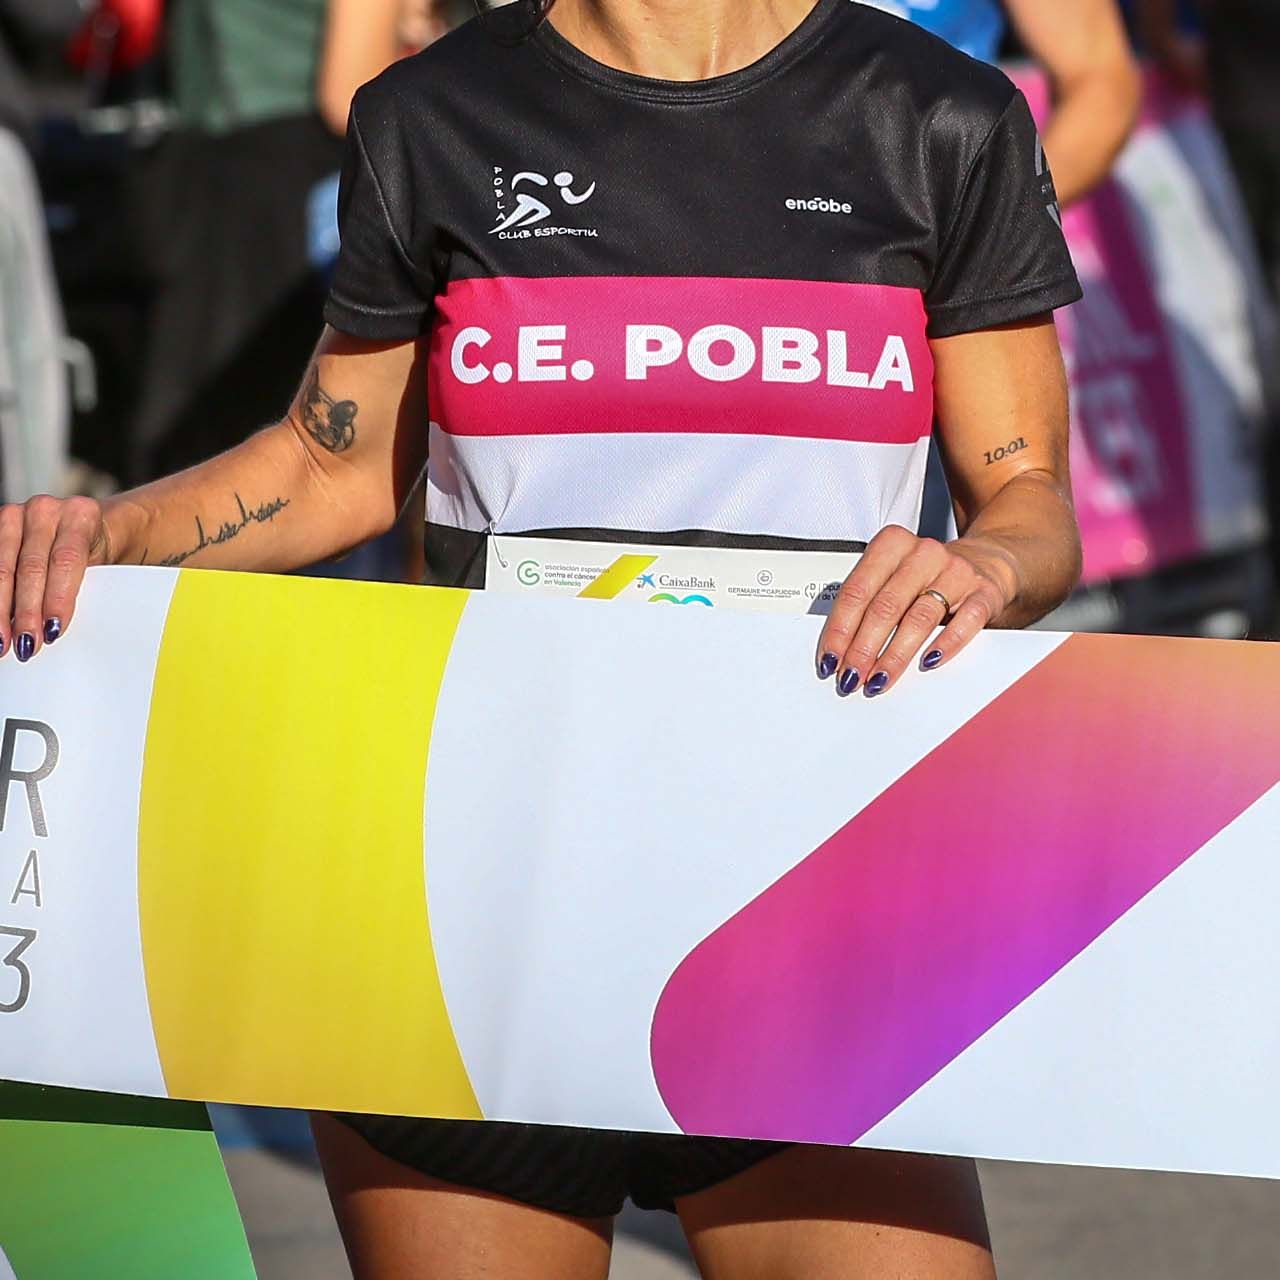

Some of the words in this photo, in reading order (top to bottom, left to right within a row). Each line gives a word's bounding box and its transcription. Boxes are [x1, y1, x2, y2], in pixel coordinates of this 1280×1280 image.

[493, 166, 506, 221] POBLA
[498, 227, 532, 239] CLUB
[534, 225, 599, 239] ESPORTIU
[451, 324, 595, 385] C.E.
[625, 324, 915, 392] POBLA
[984, 437, 1029, 466] 10:01
[659, 574, 716, 589] CaixaBank
